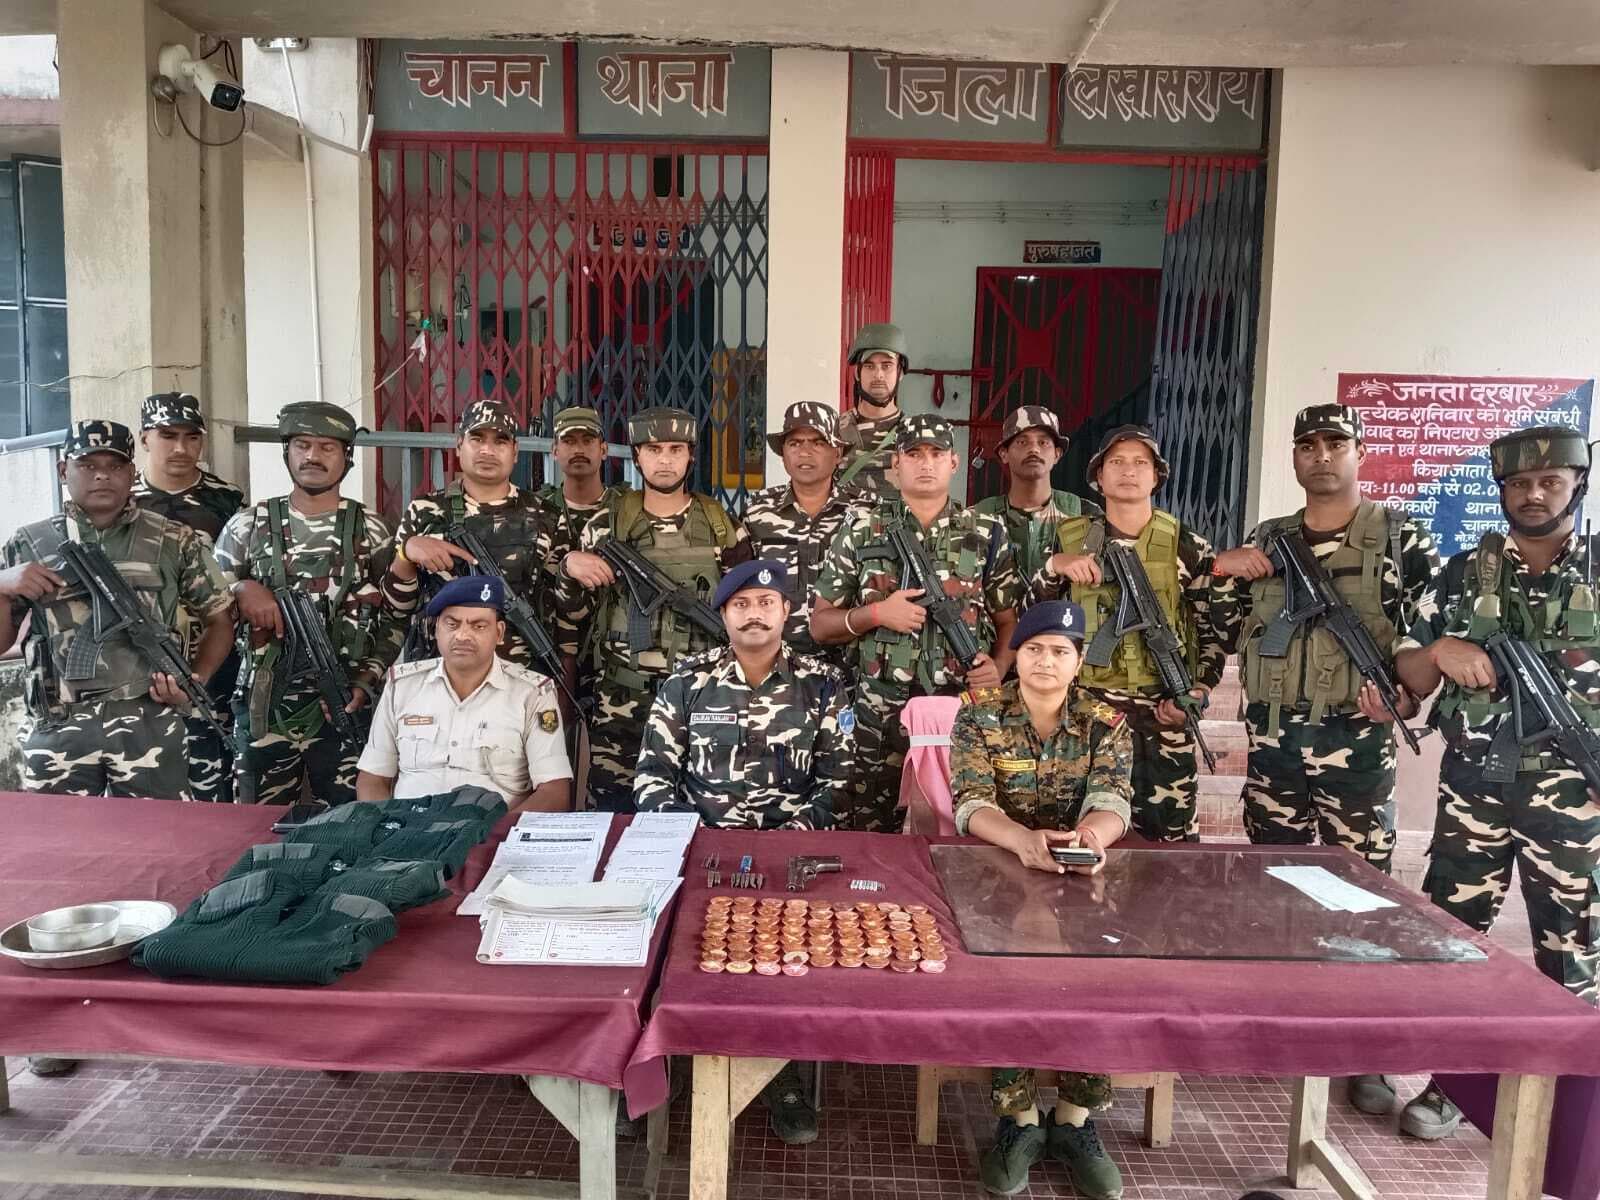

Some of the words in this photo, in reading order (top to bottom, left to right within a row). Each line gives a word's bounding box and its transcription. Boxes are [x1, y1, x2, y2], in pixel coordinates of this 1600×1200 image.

[405, 53, 550, 108] चानन
[597, 52, 735, 118] थाना
[874, 55, 1046, 125] जिला
[1393, 382, 1468, 403] जनता
[1470, 383, 1537, 407] दरबार
[1352, 401, 1410, 421] त्येक
[1476, 403, 1501, 423] को
[1503, 405, 1533, 427] भूमि
[1534, 405, 1582, 432] संबंधी
[1395, 427, 1420, 440] का
[1422, 422, 1480, 441] निपटारा
[1397, 440, 1417, 456] एवं
[1412, 459, 1449, 477] किया
[1450, 464, 1486, 479] जाता
[1416, 479, 1441, 496] बजे
[1443, 479, 1461, 496] से
[1463, 482, 1501, 496] 02.0
